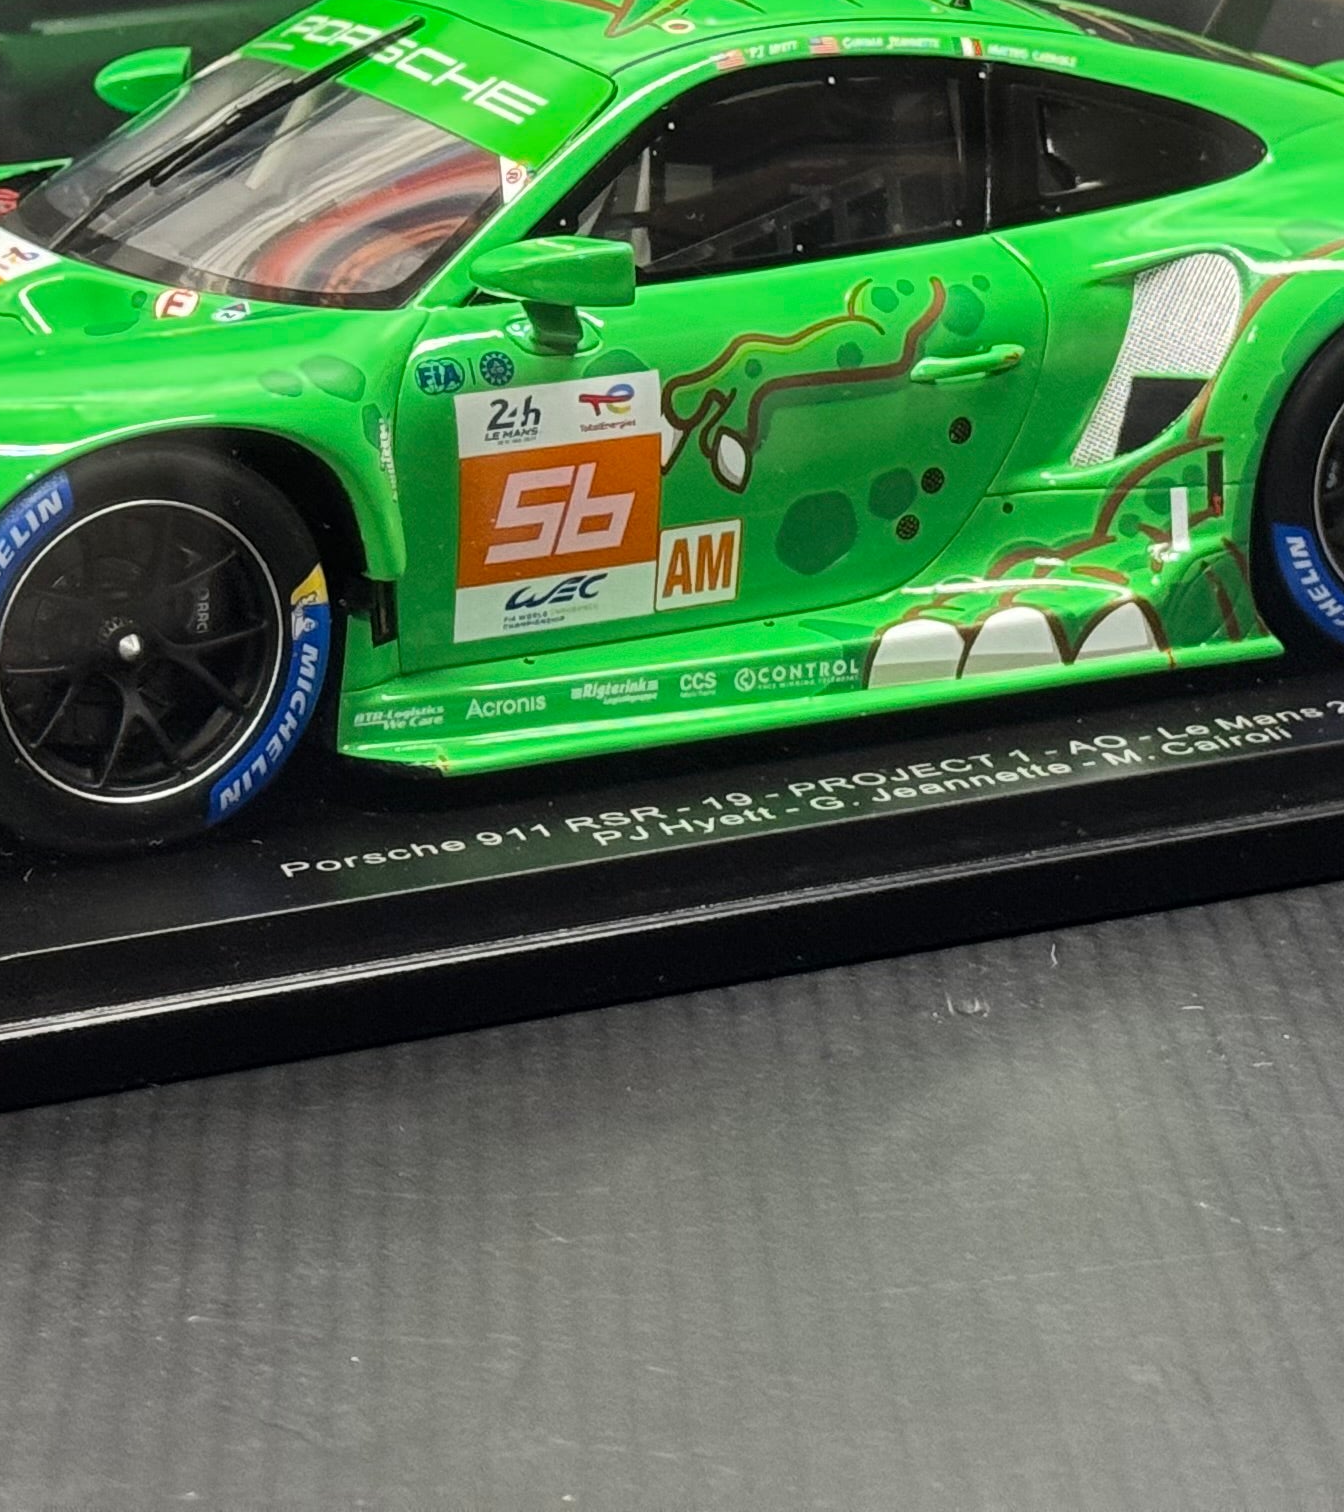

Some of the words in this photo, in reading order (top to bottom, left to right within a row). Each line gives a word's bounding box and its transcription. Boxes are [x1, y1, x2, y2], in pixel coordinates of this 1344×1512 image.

[280, 15, 549, 125] PORSCHE
[417, 360, 463, 391] FIA
[484, 431, 499, 442] LE
[503, 427, 538, 439] MANS
[484, 462, 636, 565] 56
[505, 573, 608, 610] WEC
[662, 532, 736, 600] AM
[680, 672, 717, 691] CCS
[758, 659, 860, 684] CONTROL
[220, 640, 319, 812] MICHELIN
[465, 695, 546, 720] Acronis
[280, 840, 466, 878] Porsche
[476, 823, 551, 846] 911
[565, 806, 668, 833] RSR
[702, 792, 753, 810] 19
[788, 753, 994, 798] PROJECT
[1008, 749, 1031, 763] 1
[1069, 735, 1128, 755] AO
[1157, 724, 1210, 740] Le
[1214, 707, 1324, 731] Mans
[593, 825, 649, 846] PJ
[659, 806, 777, 835] Hyett
[810, 796, 860, 810] G.
[871, 761, 1073, 803] Jeannette
[1101, 748, 1156, 766] M.
[1161, 725, 1292, 756] Cairoli
